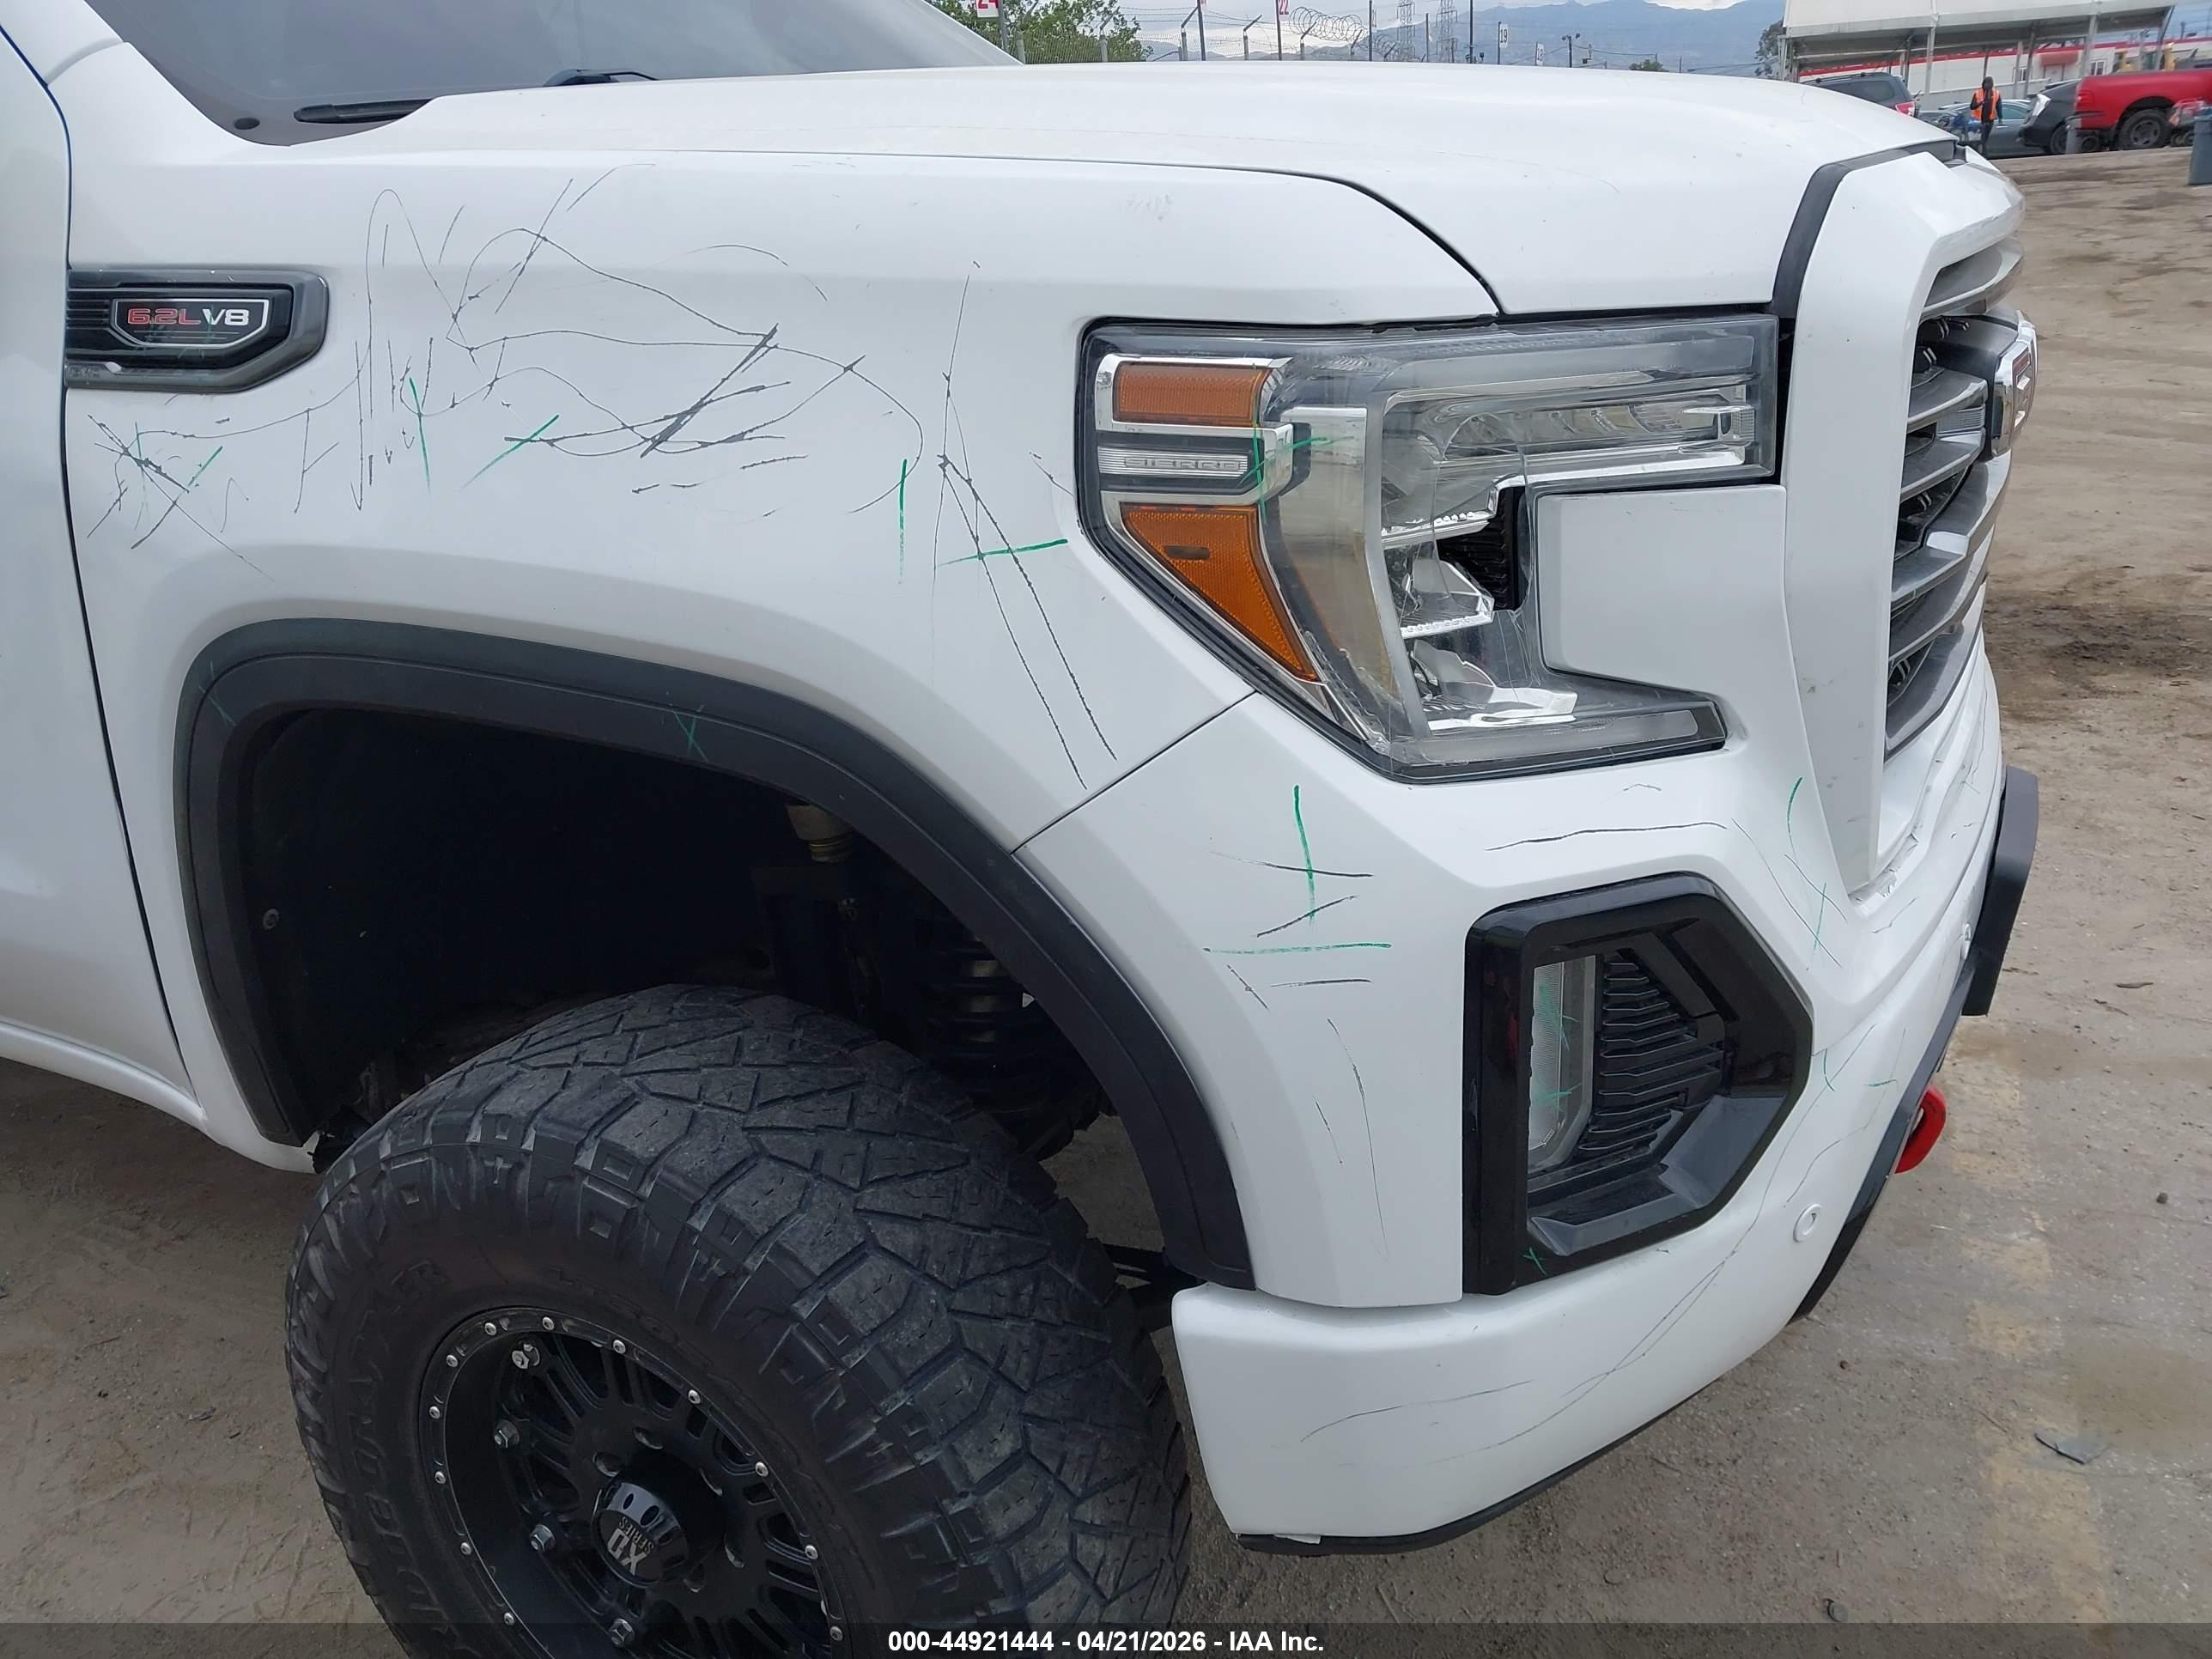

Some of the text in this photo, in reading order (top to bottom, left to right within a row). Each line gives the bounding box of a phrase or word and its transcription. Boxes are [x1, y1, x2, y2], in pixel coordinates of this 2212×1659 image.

[1500, 28, 1508, 43] 19
[1124, 457, 1240, 471] SIERRA
[619, 1516, 654, 1554] SERIES
[607, 1528, 647, 1576] XD
